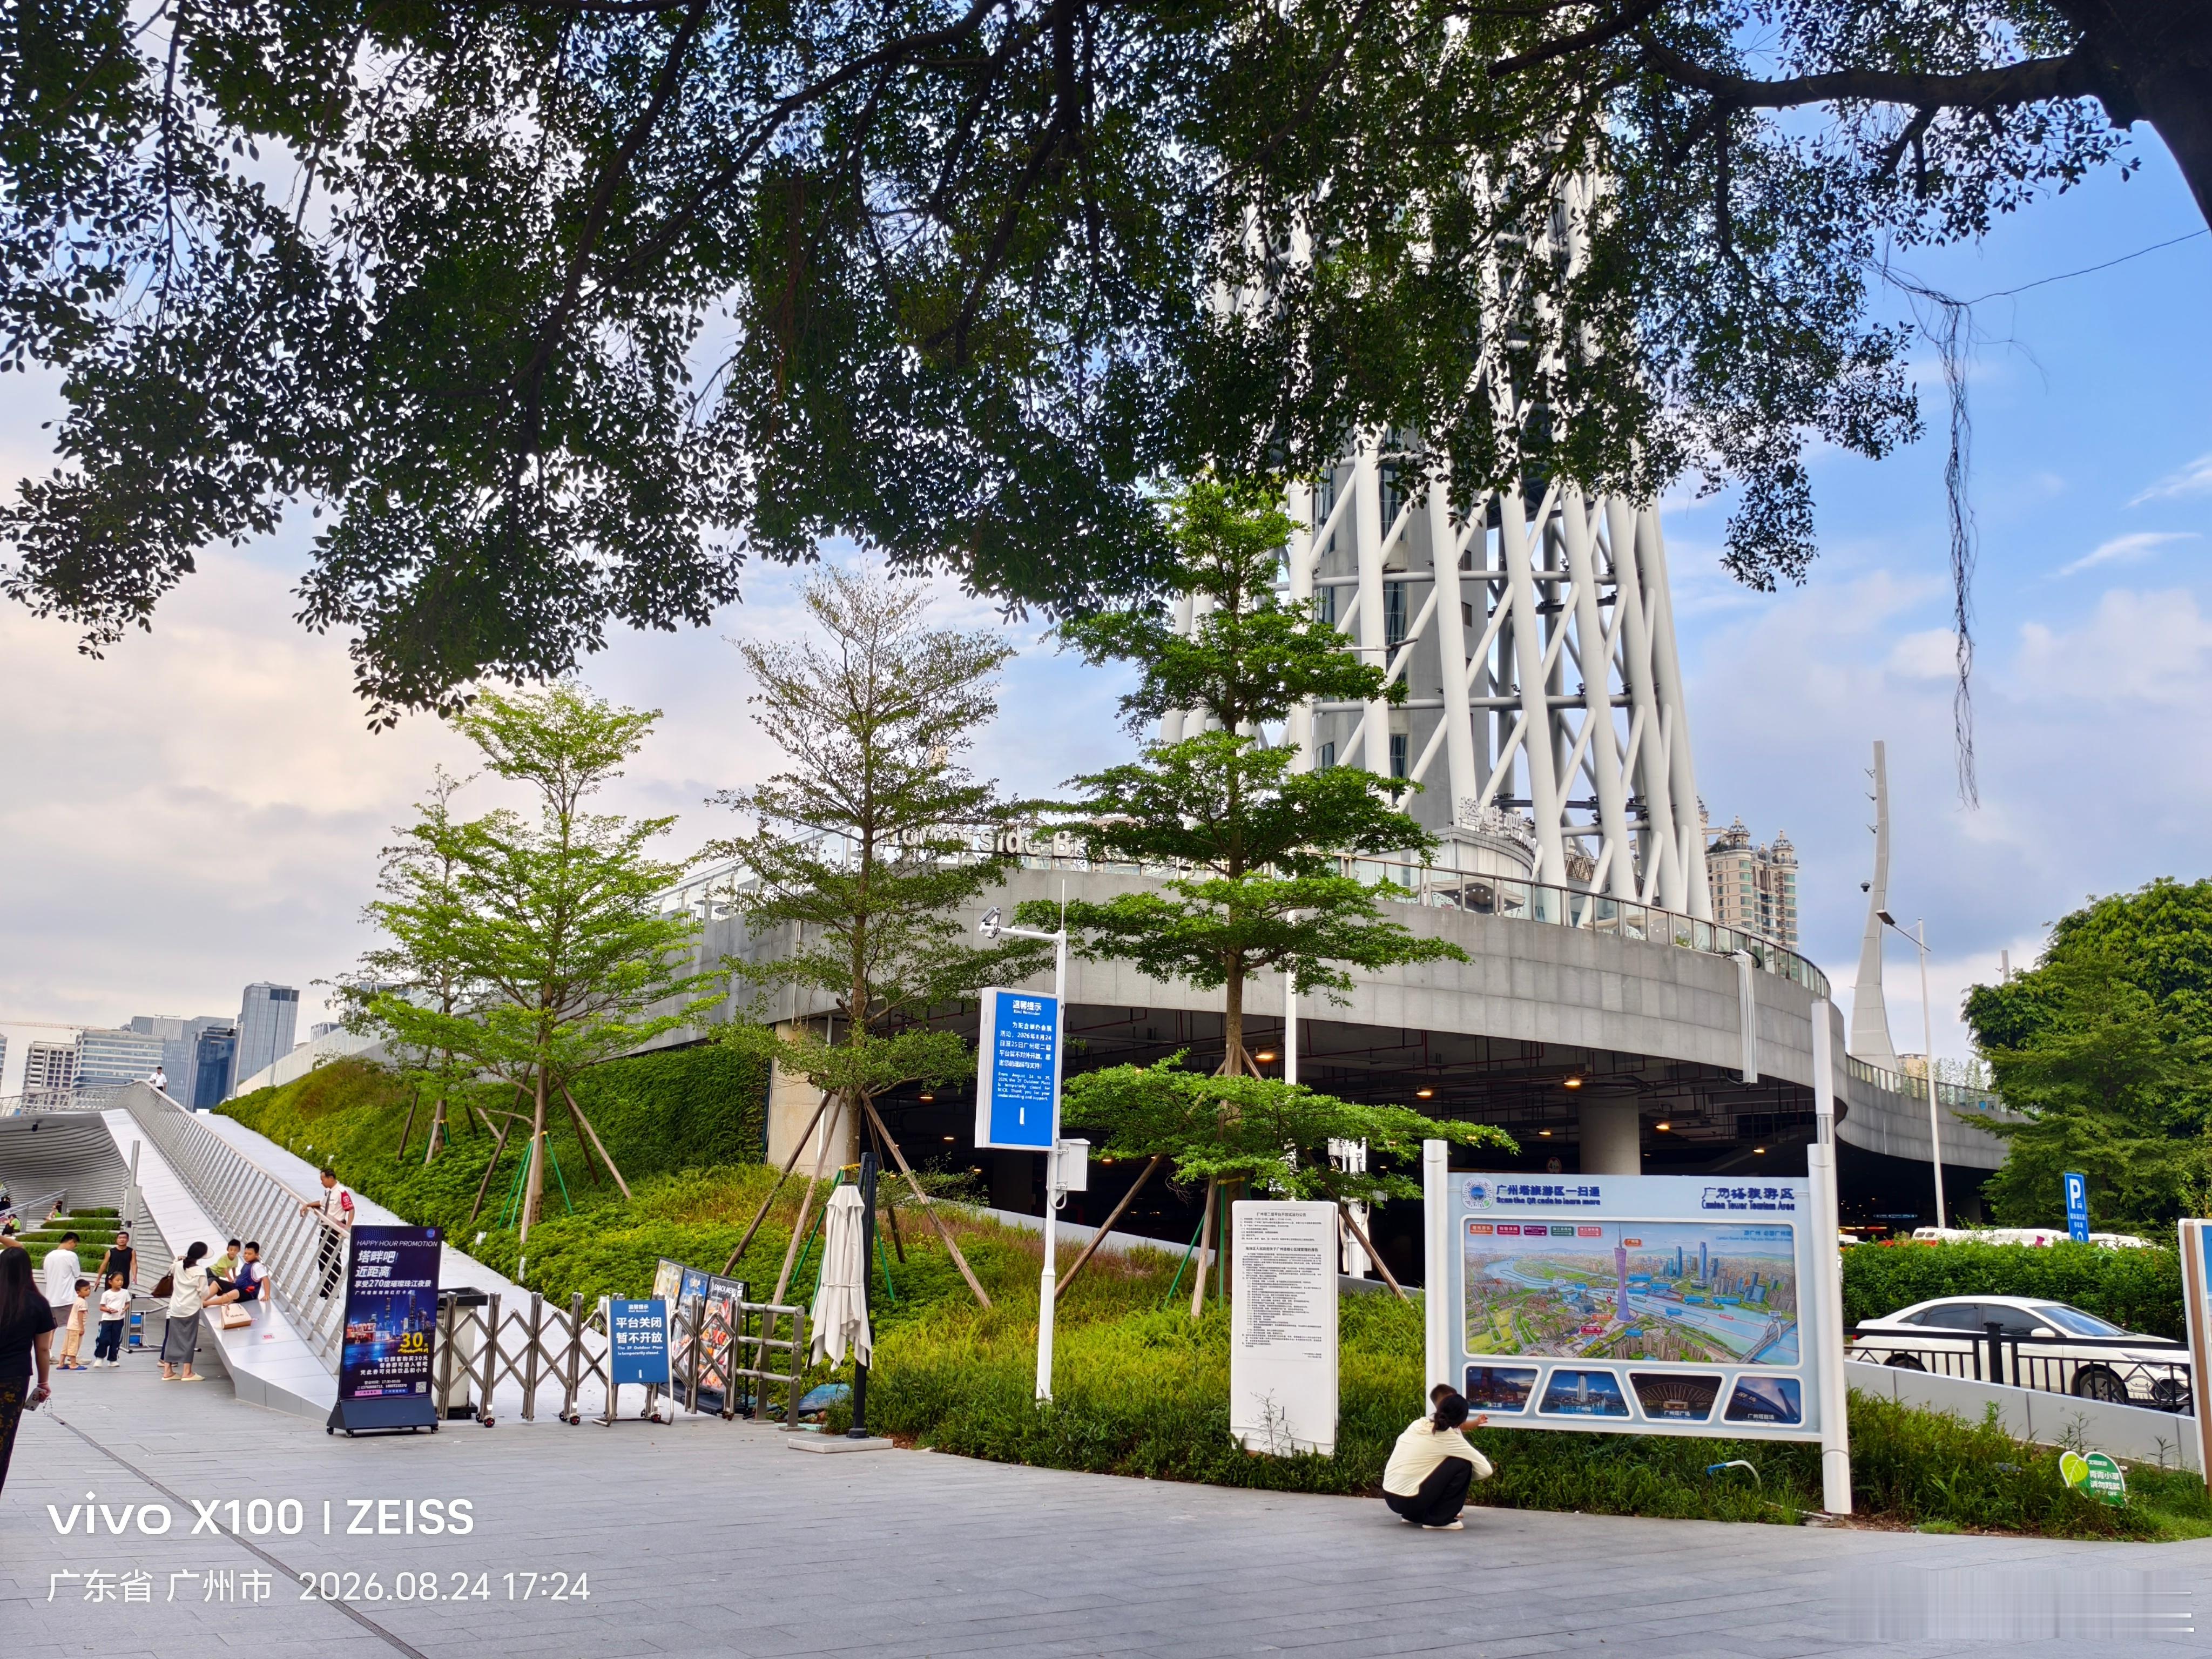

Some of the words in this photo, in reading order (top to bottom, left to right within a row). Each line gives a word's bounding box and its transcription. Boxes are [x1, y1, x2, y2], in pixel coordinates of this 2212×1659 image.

[1459, 796, 1522, 841] 塔畔吧
[1013, 1000, 1042, 1011] 温馨提示
[1496, 1185, 1600, 1197] 广州塔旅游区一扫通
[1702, 1187, 1795, 1199] 广州塔旅游区
[2069, 1178, 2081, 1209] P
[1702, 1199, 1725, 1209] Canton
[1727, 1200, 1748, 1210] Tower
[1749, 1200, 1776, 1210] Tourism
[1778, 1201, 1795, 1211] Area
[358, 1250, 397, 1264] 塔畔吧
[355, 1266, 392, 1278] 近距离
[355, 1279, 431, 1288] 享受270度璀璨珠江夜景
[714, 1284, 726, 1292] SNACK
[616, 1317, 662, 1328] 平台关闭
[400, 1332, 424, 1348] 30
[616, 1332, 663, 1344] 暂不开放
[2090, 1470, 2120, 1480] 青青小草
[2090, 1480, 2121, 1490] 请勿践踏
